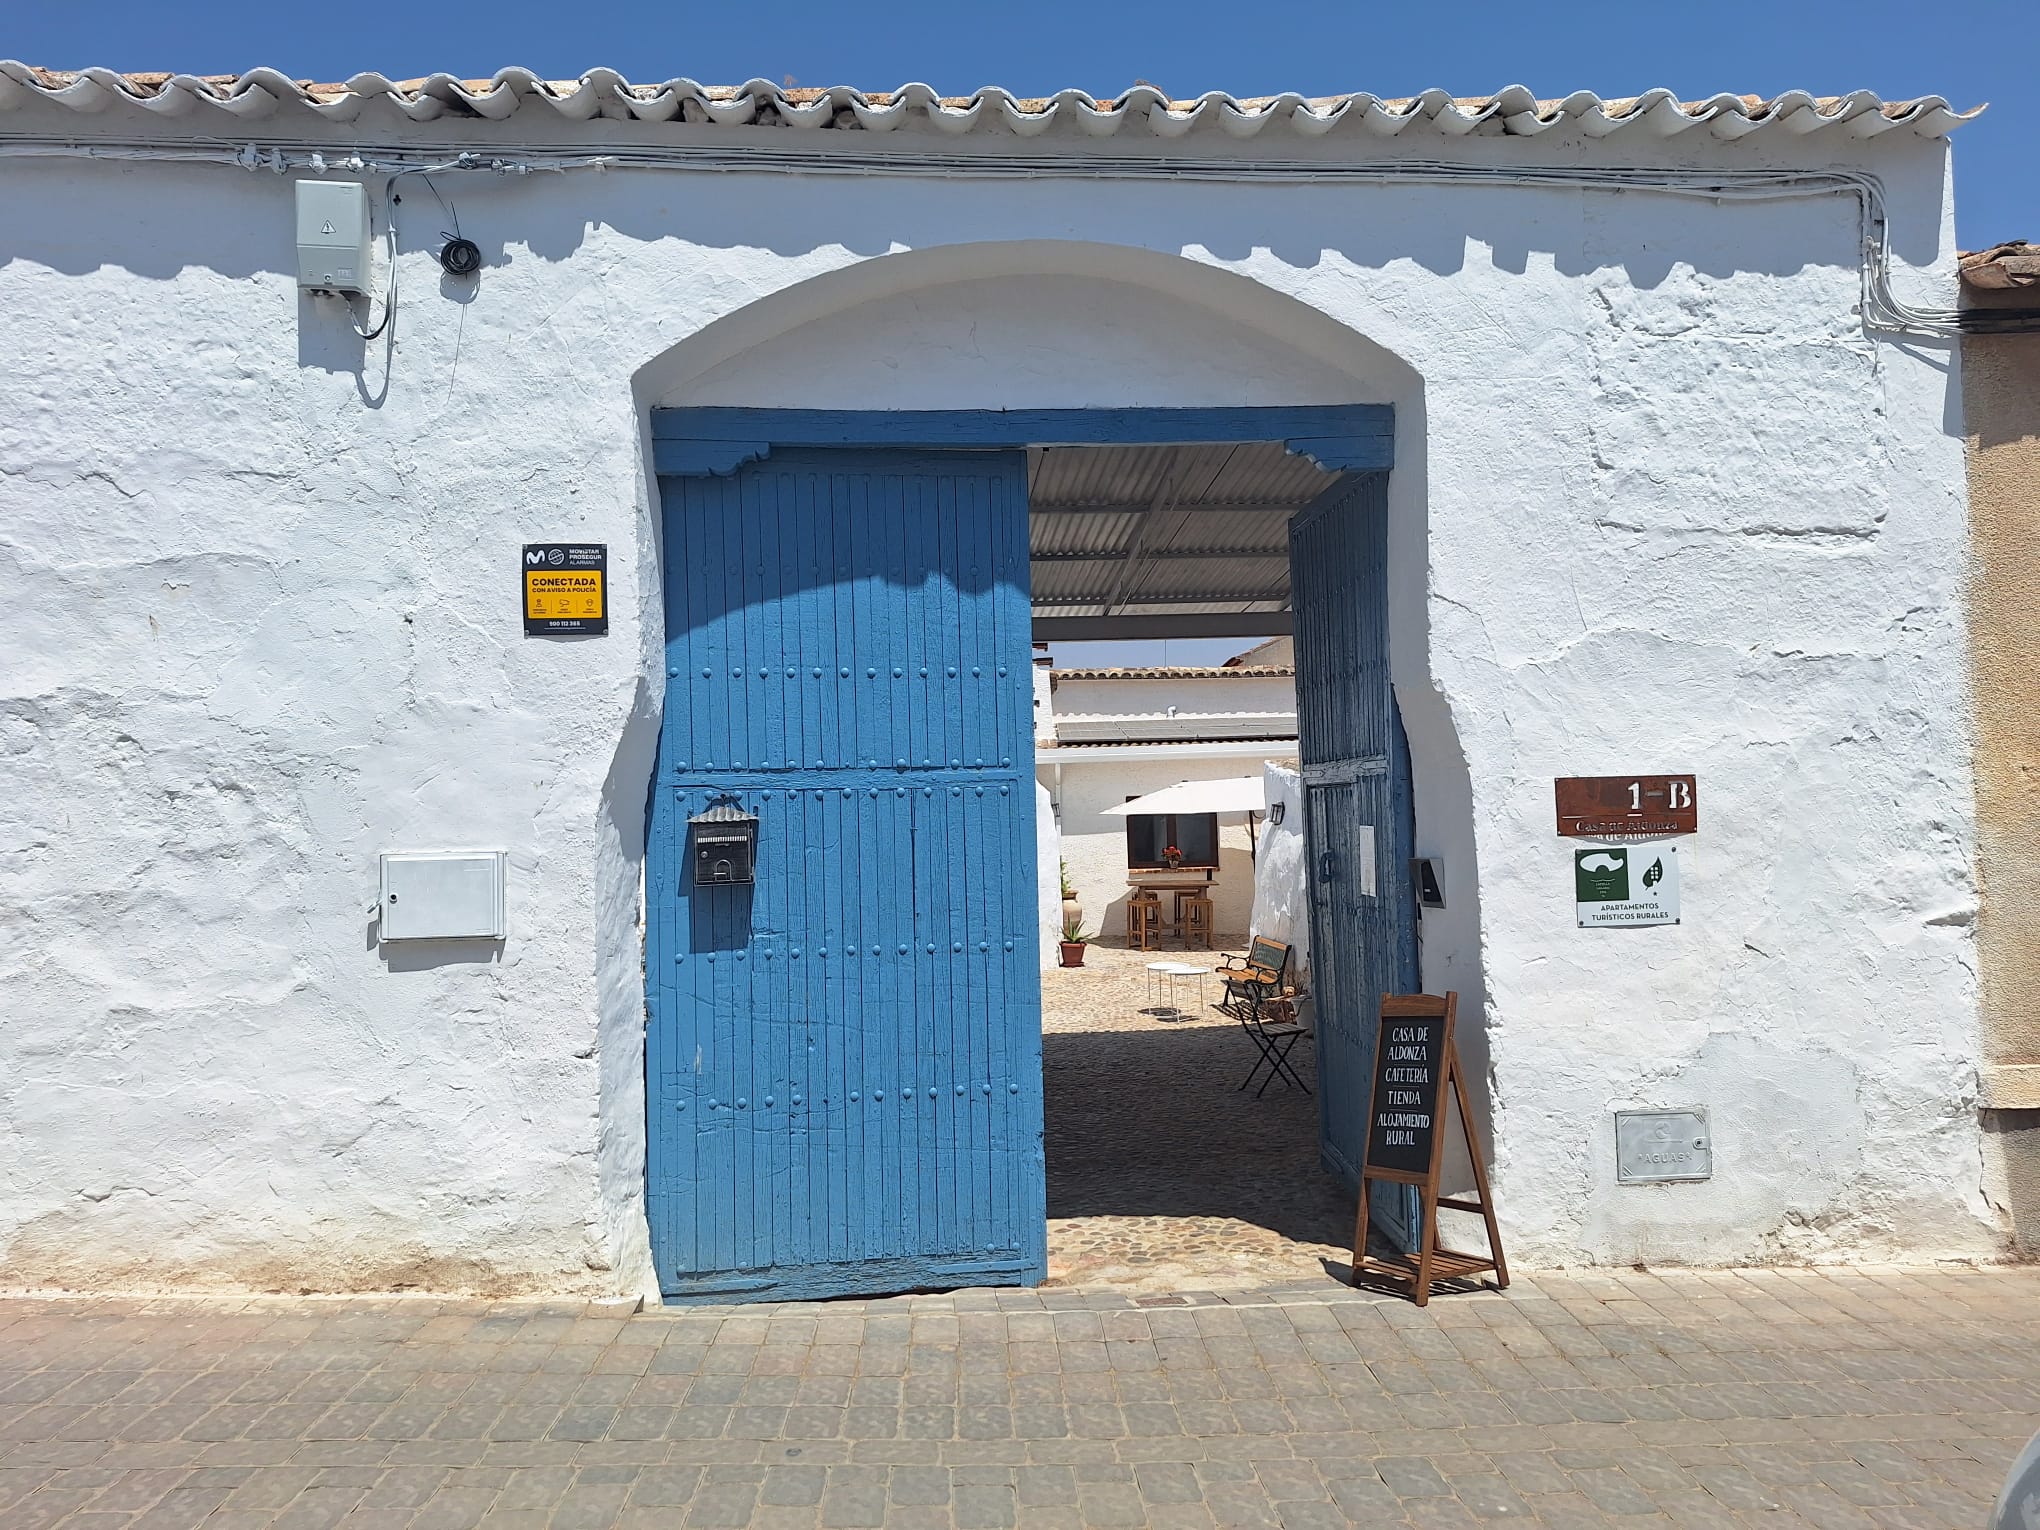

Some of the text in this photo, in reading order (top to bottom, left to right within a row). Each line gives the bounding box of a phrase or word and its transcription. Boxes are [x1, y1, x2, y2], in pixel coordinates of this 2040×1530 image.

[531, 578, 597, 586] CONECTADA
[1600, 902, 1660, 912] APARTAMENTOS
[1592, 911, 1669, 921] TURÍSTICOS RURALES
[1392, 1026, 1429, 1042] CASA DE
[1387, 1046, 1428, 1061] ALDONZA
[1385, 1064, 1429, 1083] CAFETERÍA
[1387, 1090, 1421, 1105] TIENDA
[1377, 1113, 1430, 1129] ALOJAMIENTO
[1385, 1130, 1415, 1146] RURAL
[1643, 1152, 1684, 1164] AGUAS
